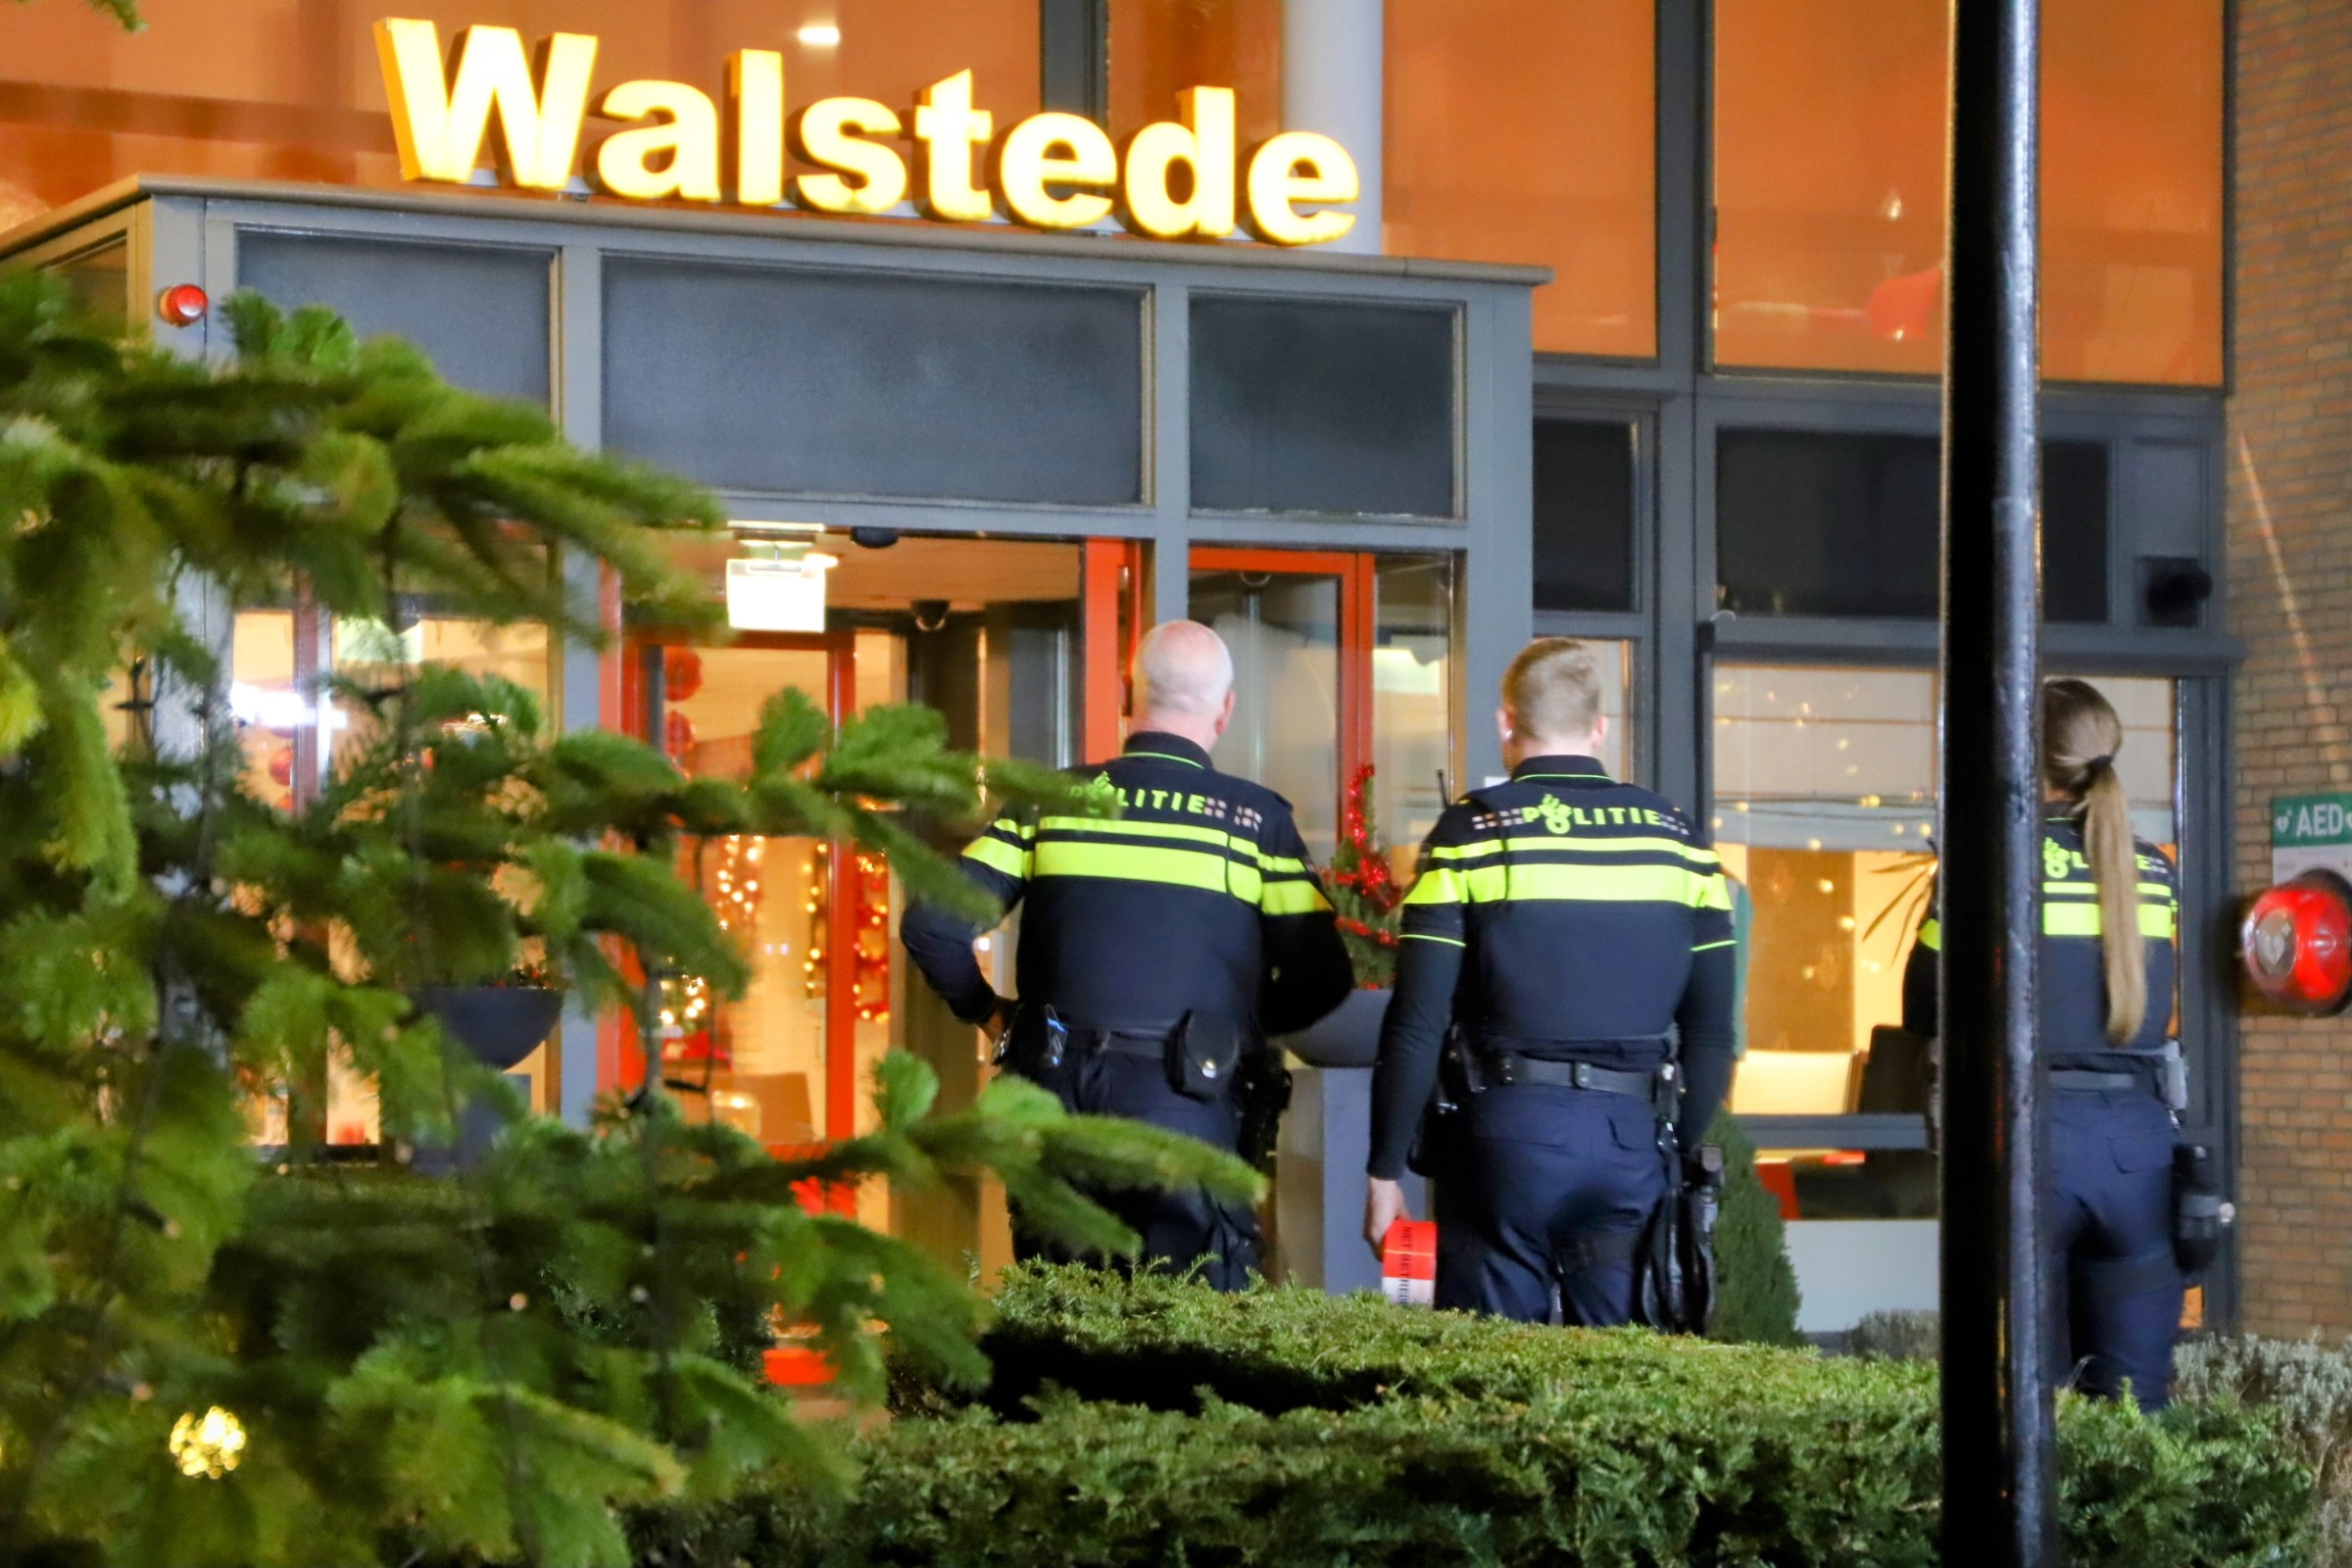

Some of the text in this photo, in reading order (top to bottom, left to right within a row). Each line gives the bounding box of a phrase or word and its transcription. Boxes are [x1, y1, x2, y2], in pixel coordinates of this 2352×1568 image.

[376, 17, 1360, 246] Walstede
[1522, 794, 1662, 834] POLITIE
[2295, 804, 2344, 837] AED
